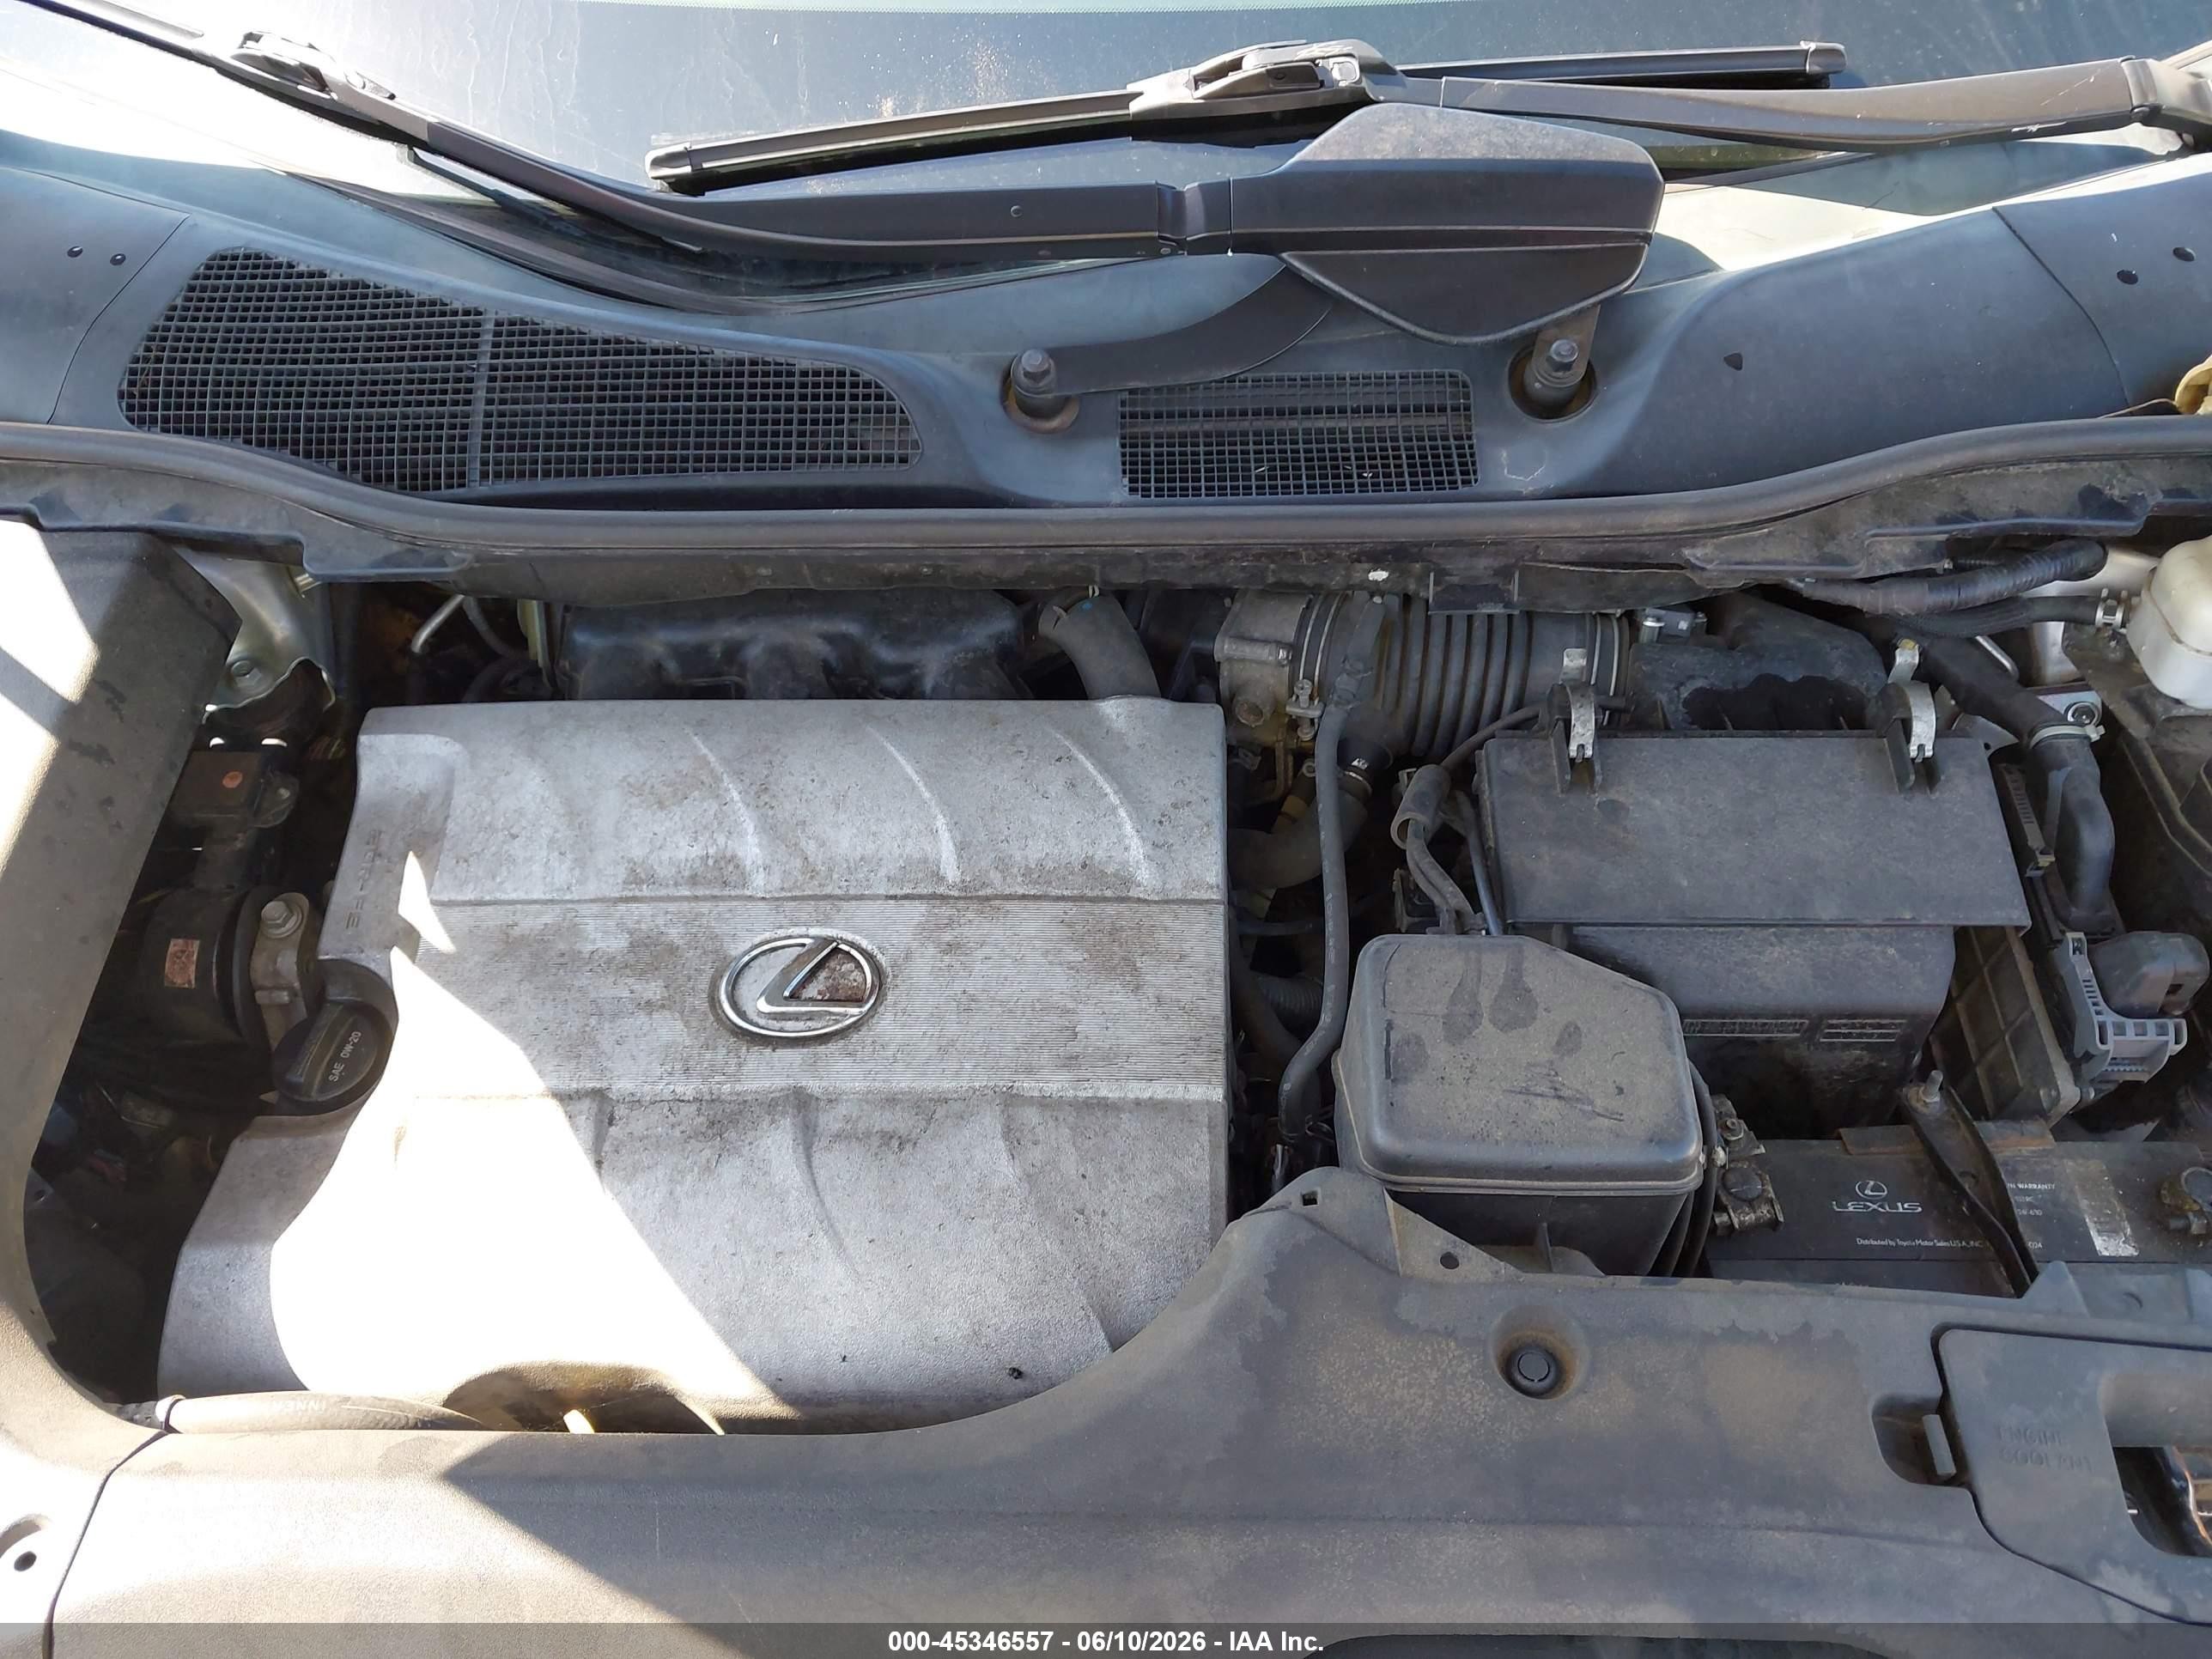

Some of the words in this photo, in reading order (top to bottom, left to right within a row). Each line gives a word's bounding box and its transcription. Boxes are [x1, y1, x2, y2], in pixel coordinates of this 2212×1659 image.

[328, 1061, 345, 1082] SAE
[340, 1030, 362, 1059] 0W-20
[1832, 1200, 1923, 1213] LEXUS
